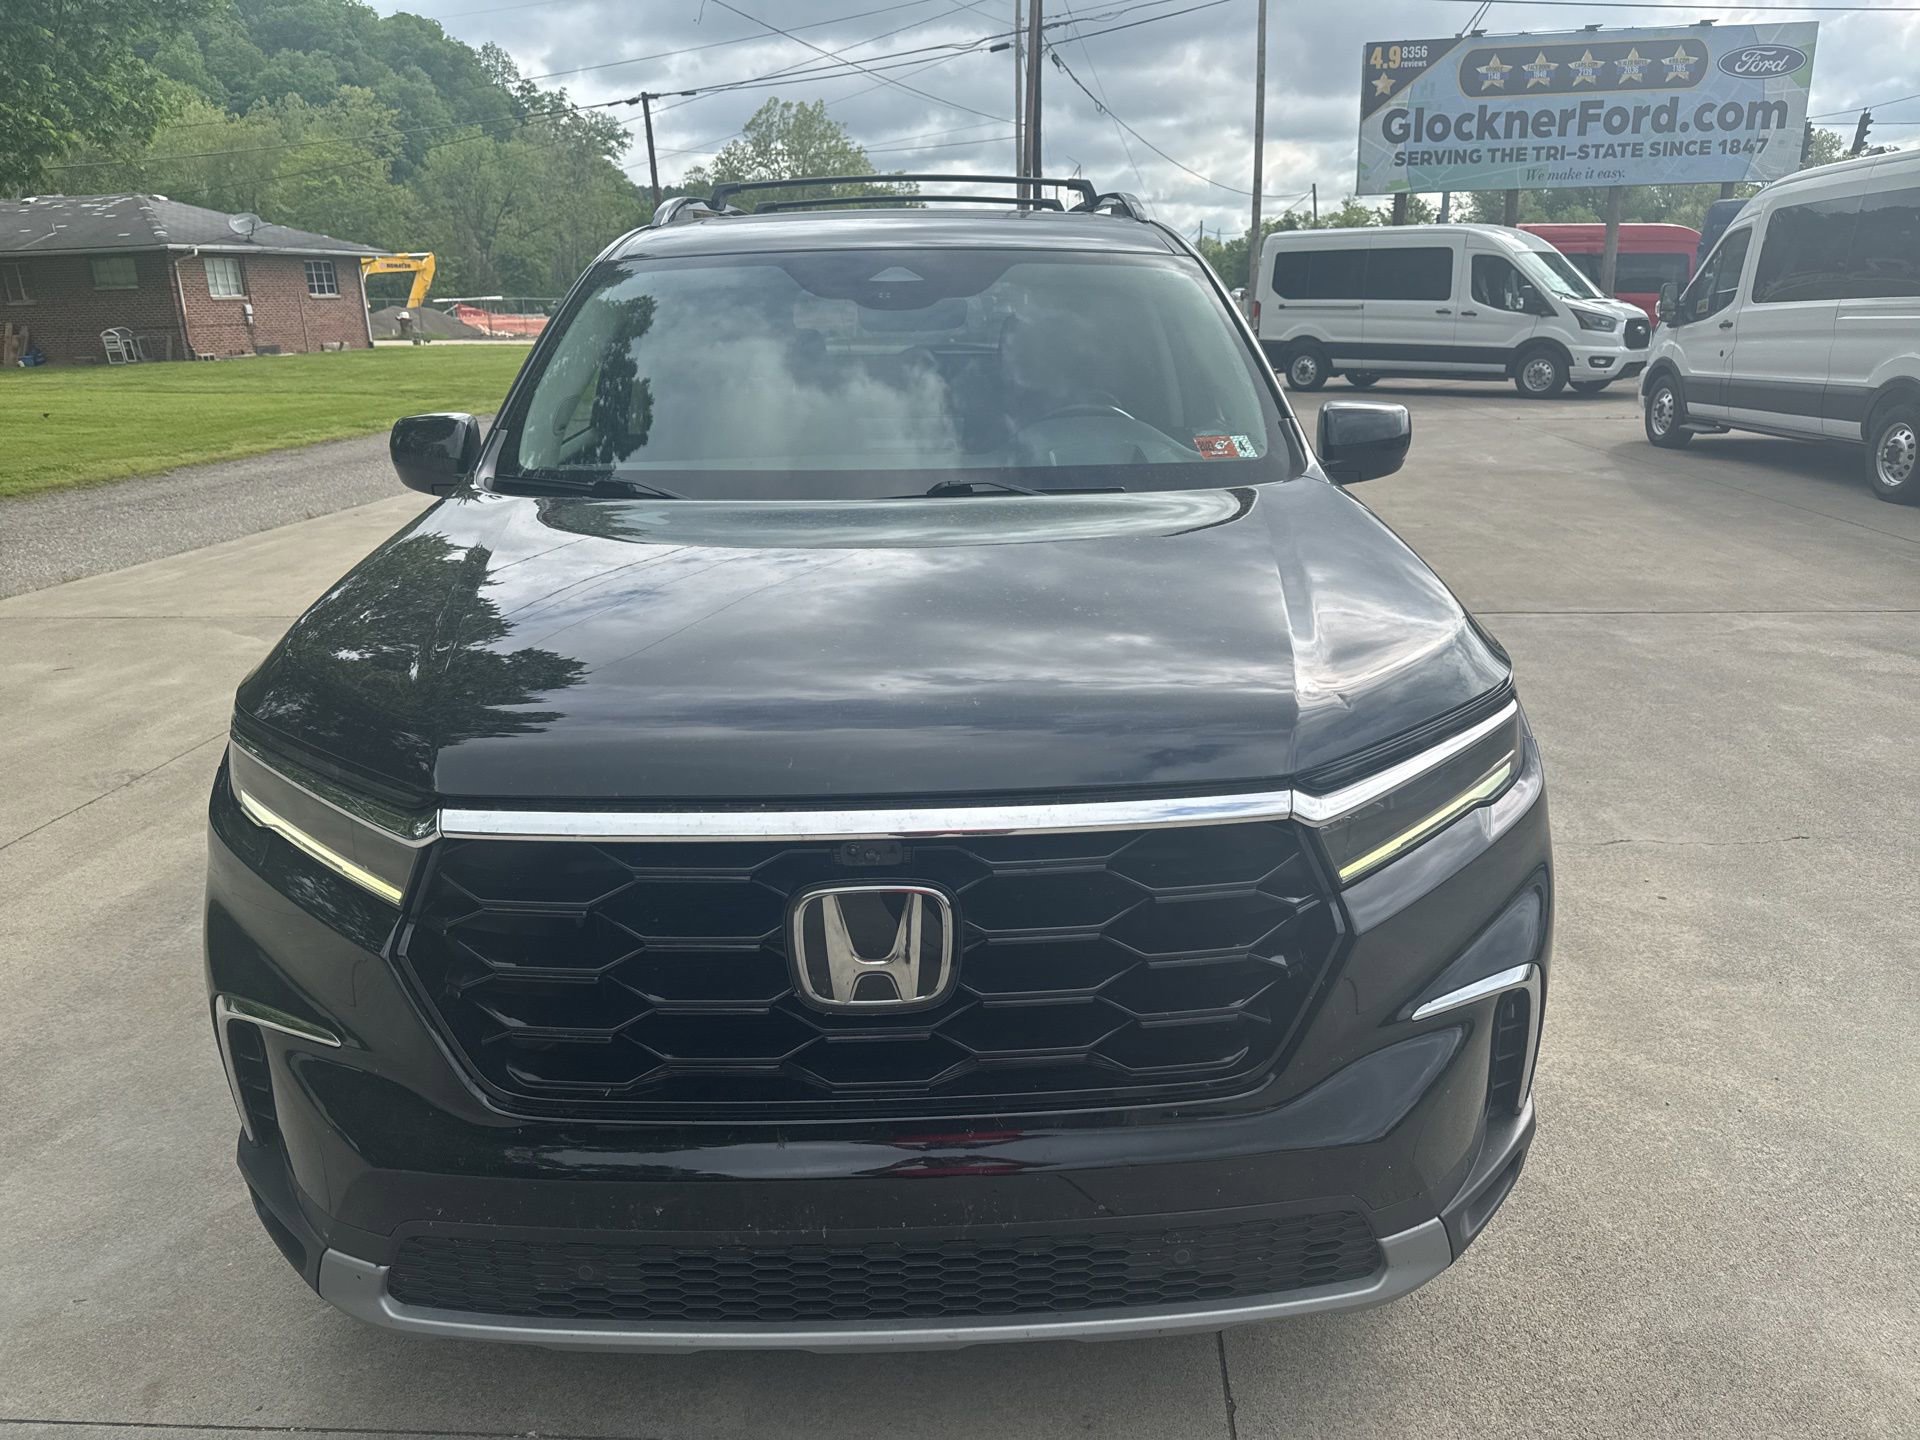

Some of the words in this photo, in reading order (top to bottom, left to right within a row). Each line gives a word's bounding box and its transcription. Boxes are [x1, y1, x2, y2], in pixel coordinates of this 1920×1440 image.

[1370, 46, 1401, 69] 4.9
[1402, 46, 1428, 59] 8356
[1735, 50, 1789, 72] Ford
[1401, 60, 1427, 68] reviews
[1382, 96, 1788, 144] GlocknerFord.com
[1394, 149, 1482, 167] SERVING
[1487, 147, 1528, 163] THE
[1532, 142, 1644, 161] TRI-STATE
[1649, 139, 1712, 157] SINCE
[1718, 138, 1769, 155] 1847
[1526, 168, 1545, 182] We
[1547, 166, 1582, 181] make
[1585, 167, 1595, 180] it
[1597, 168, 1625, 183] easy.
